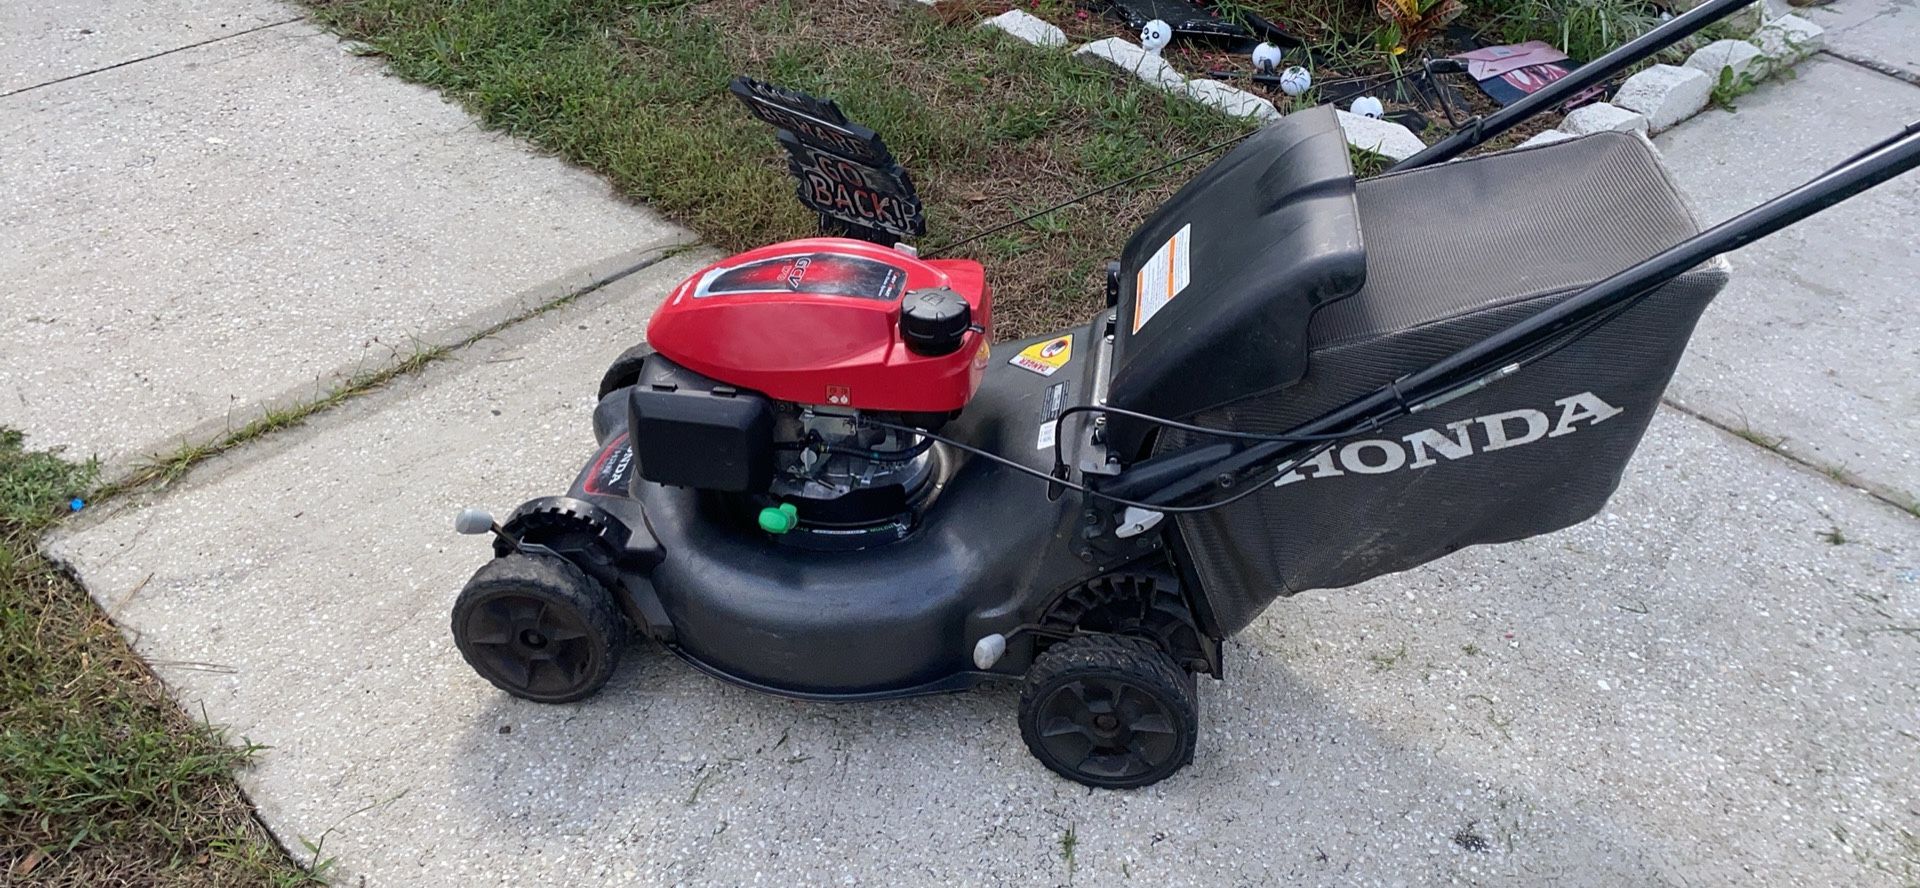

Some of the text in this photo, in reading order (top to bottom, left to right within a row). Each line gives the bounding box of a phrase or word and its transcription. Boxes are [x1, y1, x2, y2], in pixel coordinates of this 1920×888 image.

[818, 155, 864, 187] GO
[808, 173, 904, 227] BACK!
[787, 257, 812, 288] GCV
[1020, 356, 1049, 372] DANGER
[1274, 391, 1625, 488] HONDA
